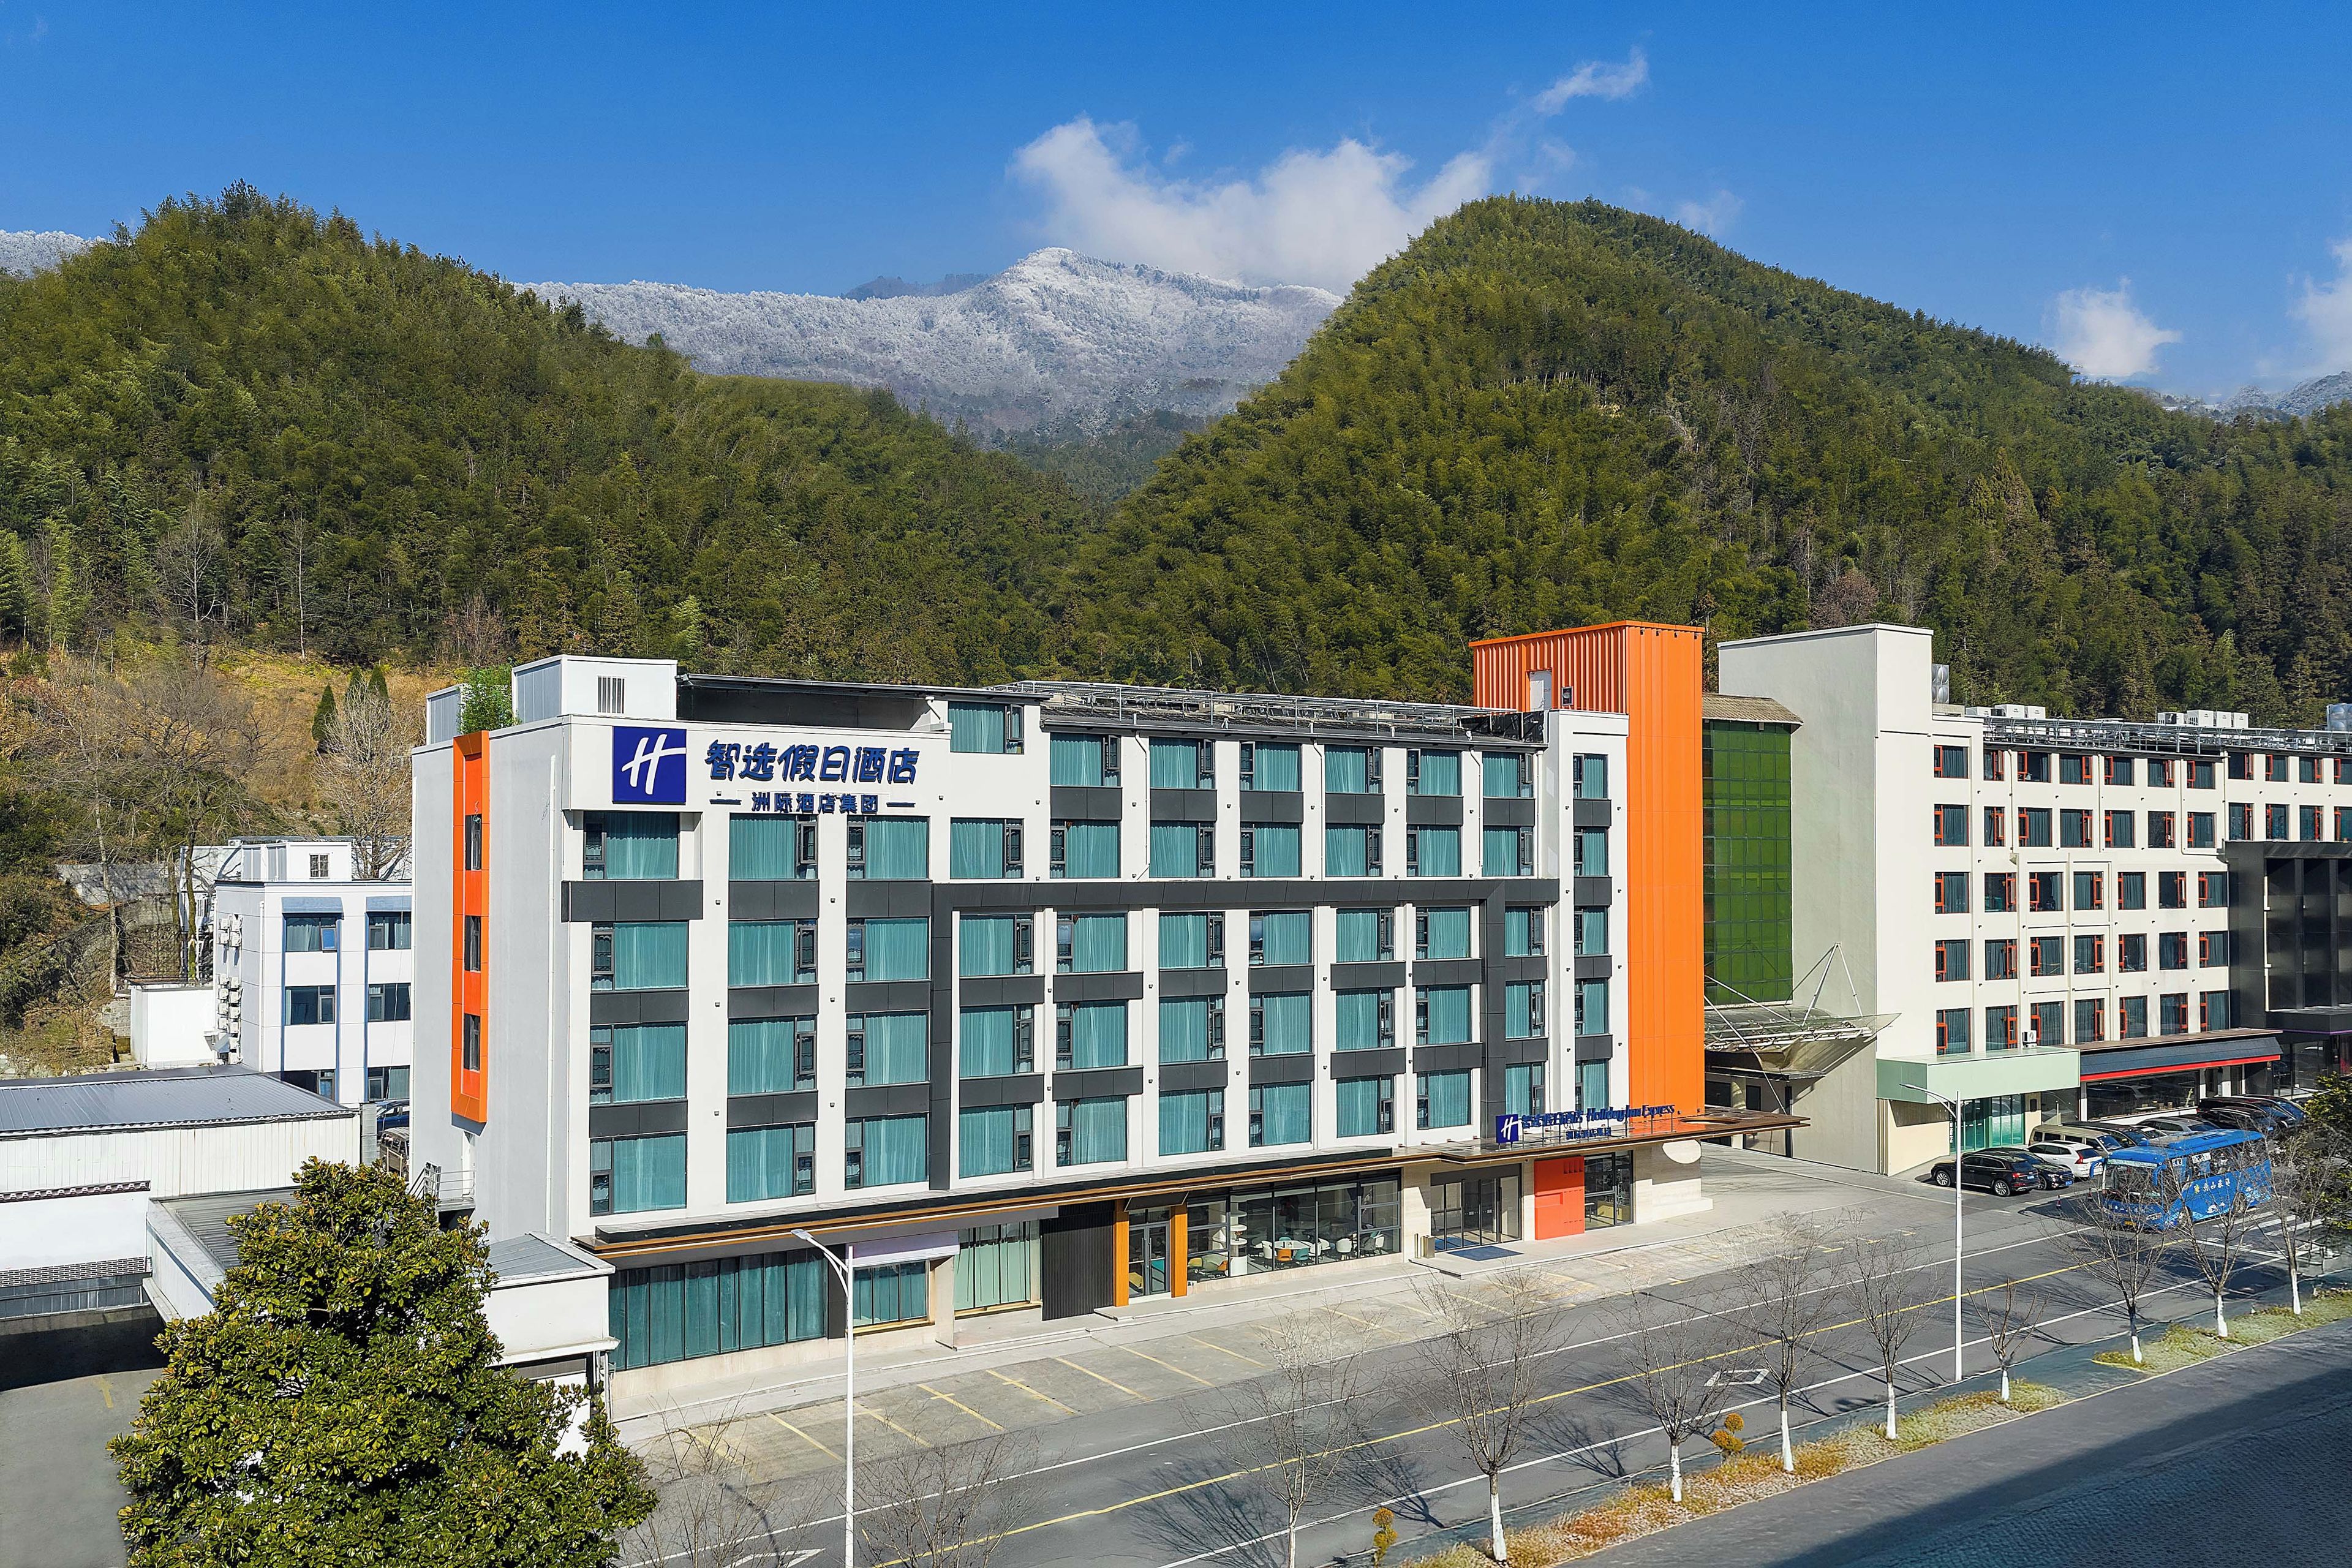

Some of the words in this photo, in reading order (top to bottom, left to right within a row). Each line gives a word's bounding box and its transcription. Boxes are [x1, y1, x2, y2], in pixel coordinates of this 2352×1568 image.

[705, 739, 920, 785] 智选假日酒店
[752, 791, 878, 814] 洲际酒店集团
[1586, 1107, 1626, 1121] Holiday
[1642, 1105, 1675, 1118] Express
